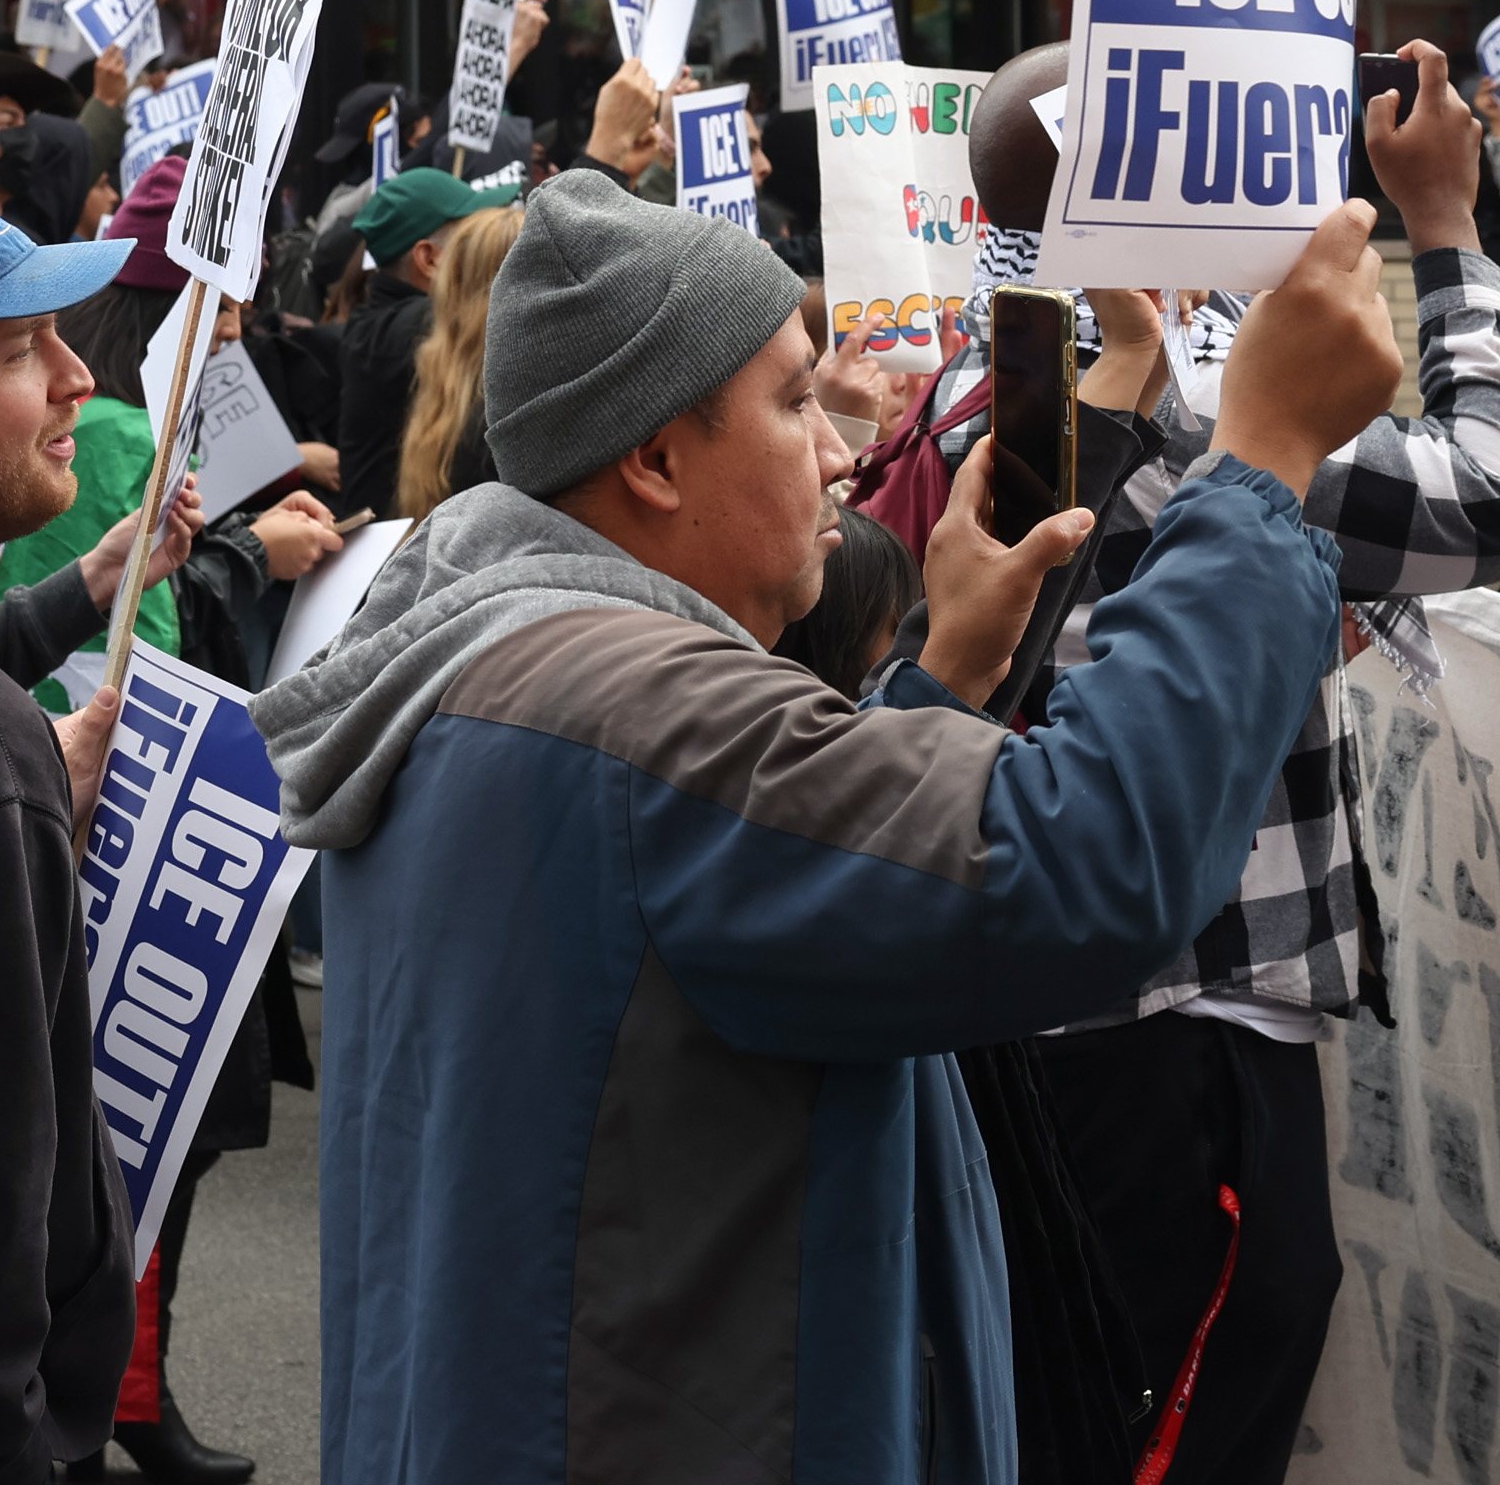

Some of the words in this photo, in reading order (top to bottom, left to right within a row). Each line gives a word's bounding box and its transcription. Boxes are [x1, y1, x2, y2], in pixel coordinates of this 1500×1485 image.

[464, 19, 507, 56] AHORA
[462, 48, 502, 82] AHORA
[141, 81, 200, 136] OUT!
[460, 78, 498, 112] AHORA
[828, 81, 897, 137] NO
[453, 107, 495, 142] AHORA
[699, 113, 739, 180] ICE
[149, 777, 281, 945] ICE
